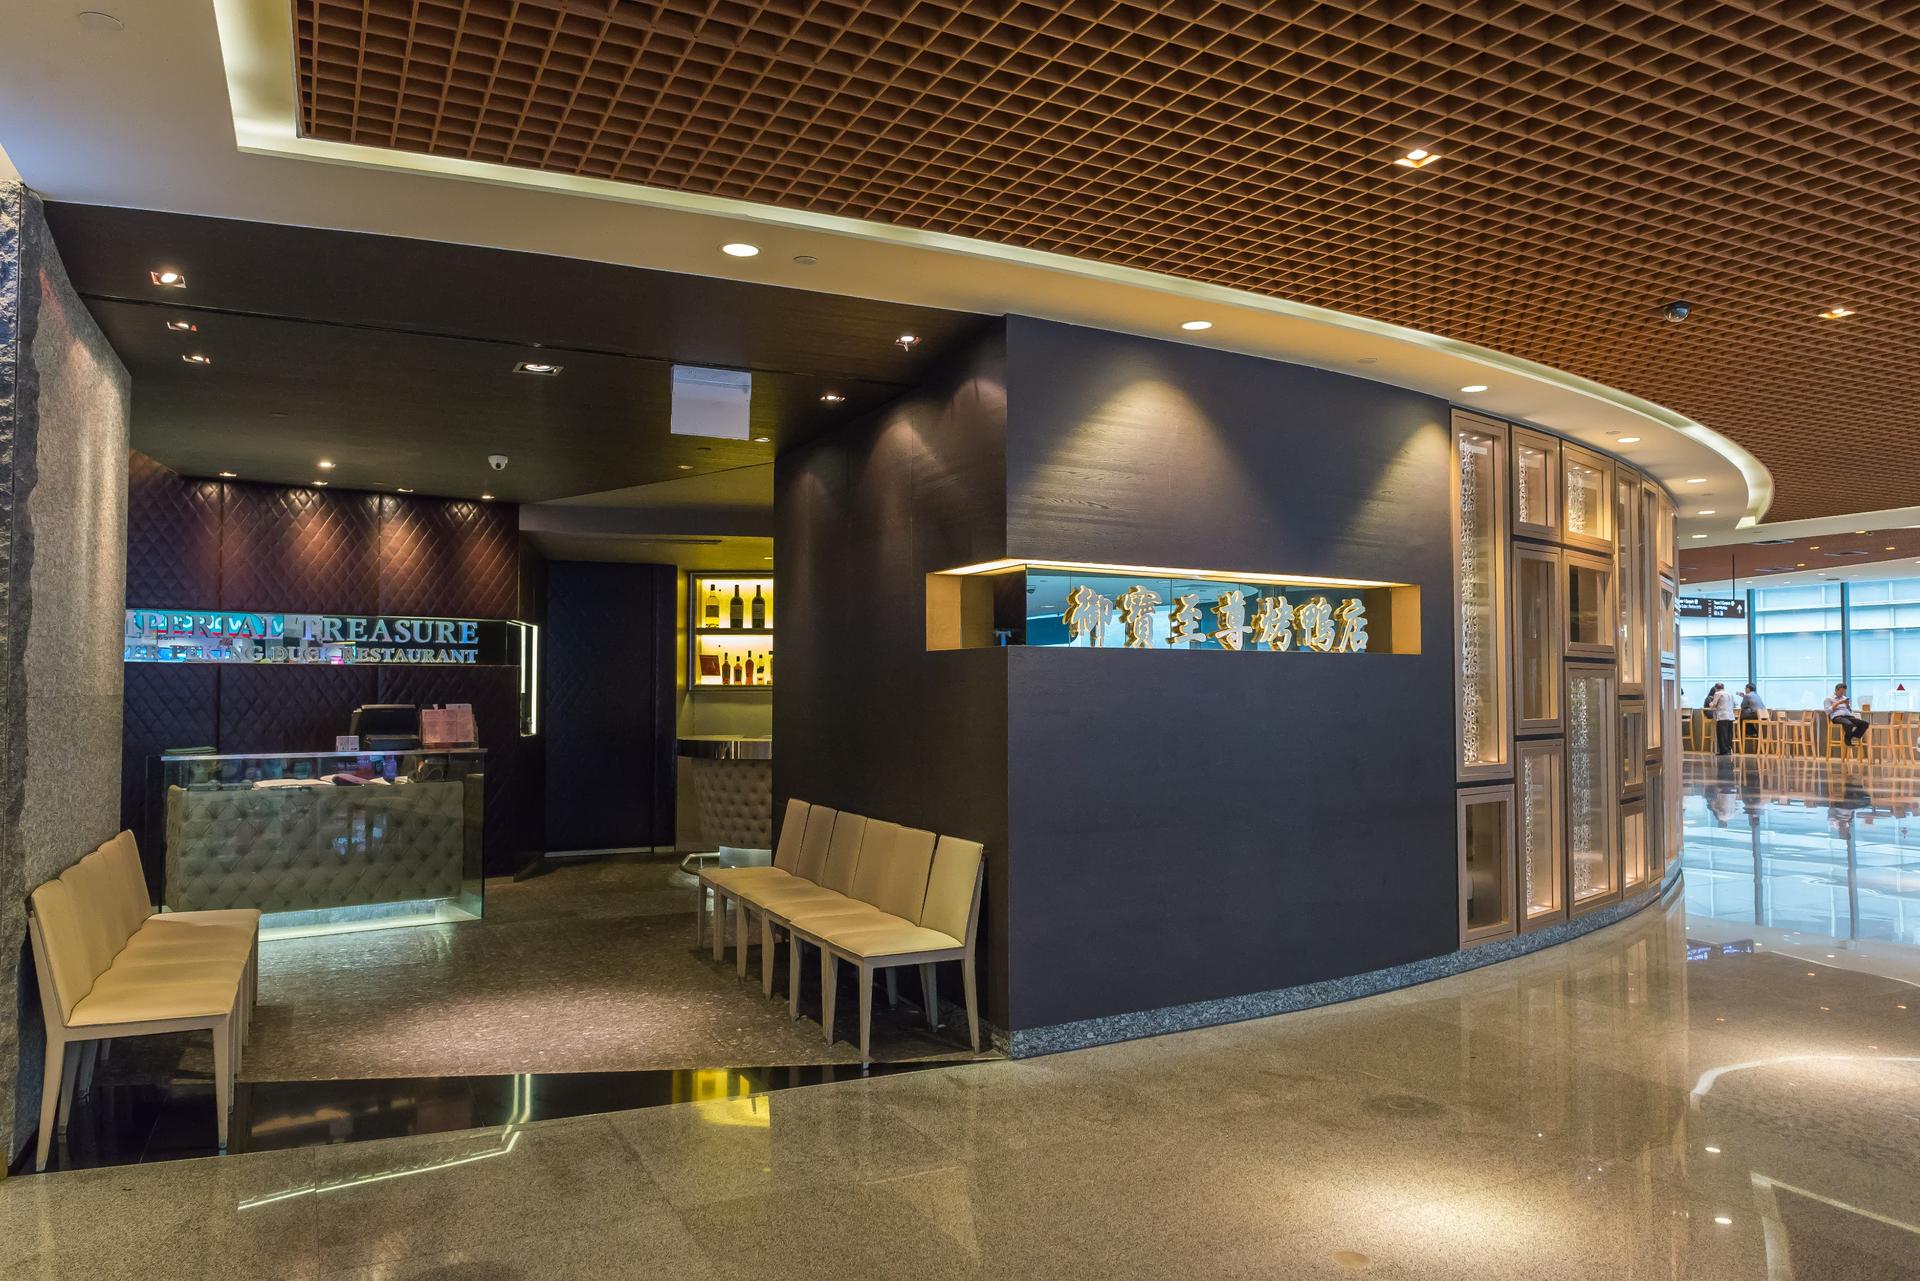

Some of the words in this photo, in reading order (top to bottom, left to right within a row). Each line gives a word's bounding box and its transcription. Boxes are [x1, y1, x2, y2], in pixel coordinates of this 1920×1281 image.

[300, 616, 478, 644] TREASURE
[128, 645, 159, 661] ER
[169, 646, 263, 661] PEKING
[271, 646, 333, 663] DUCK
[343, 647, 478, 663] RESTAURANT
